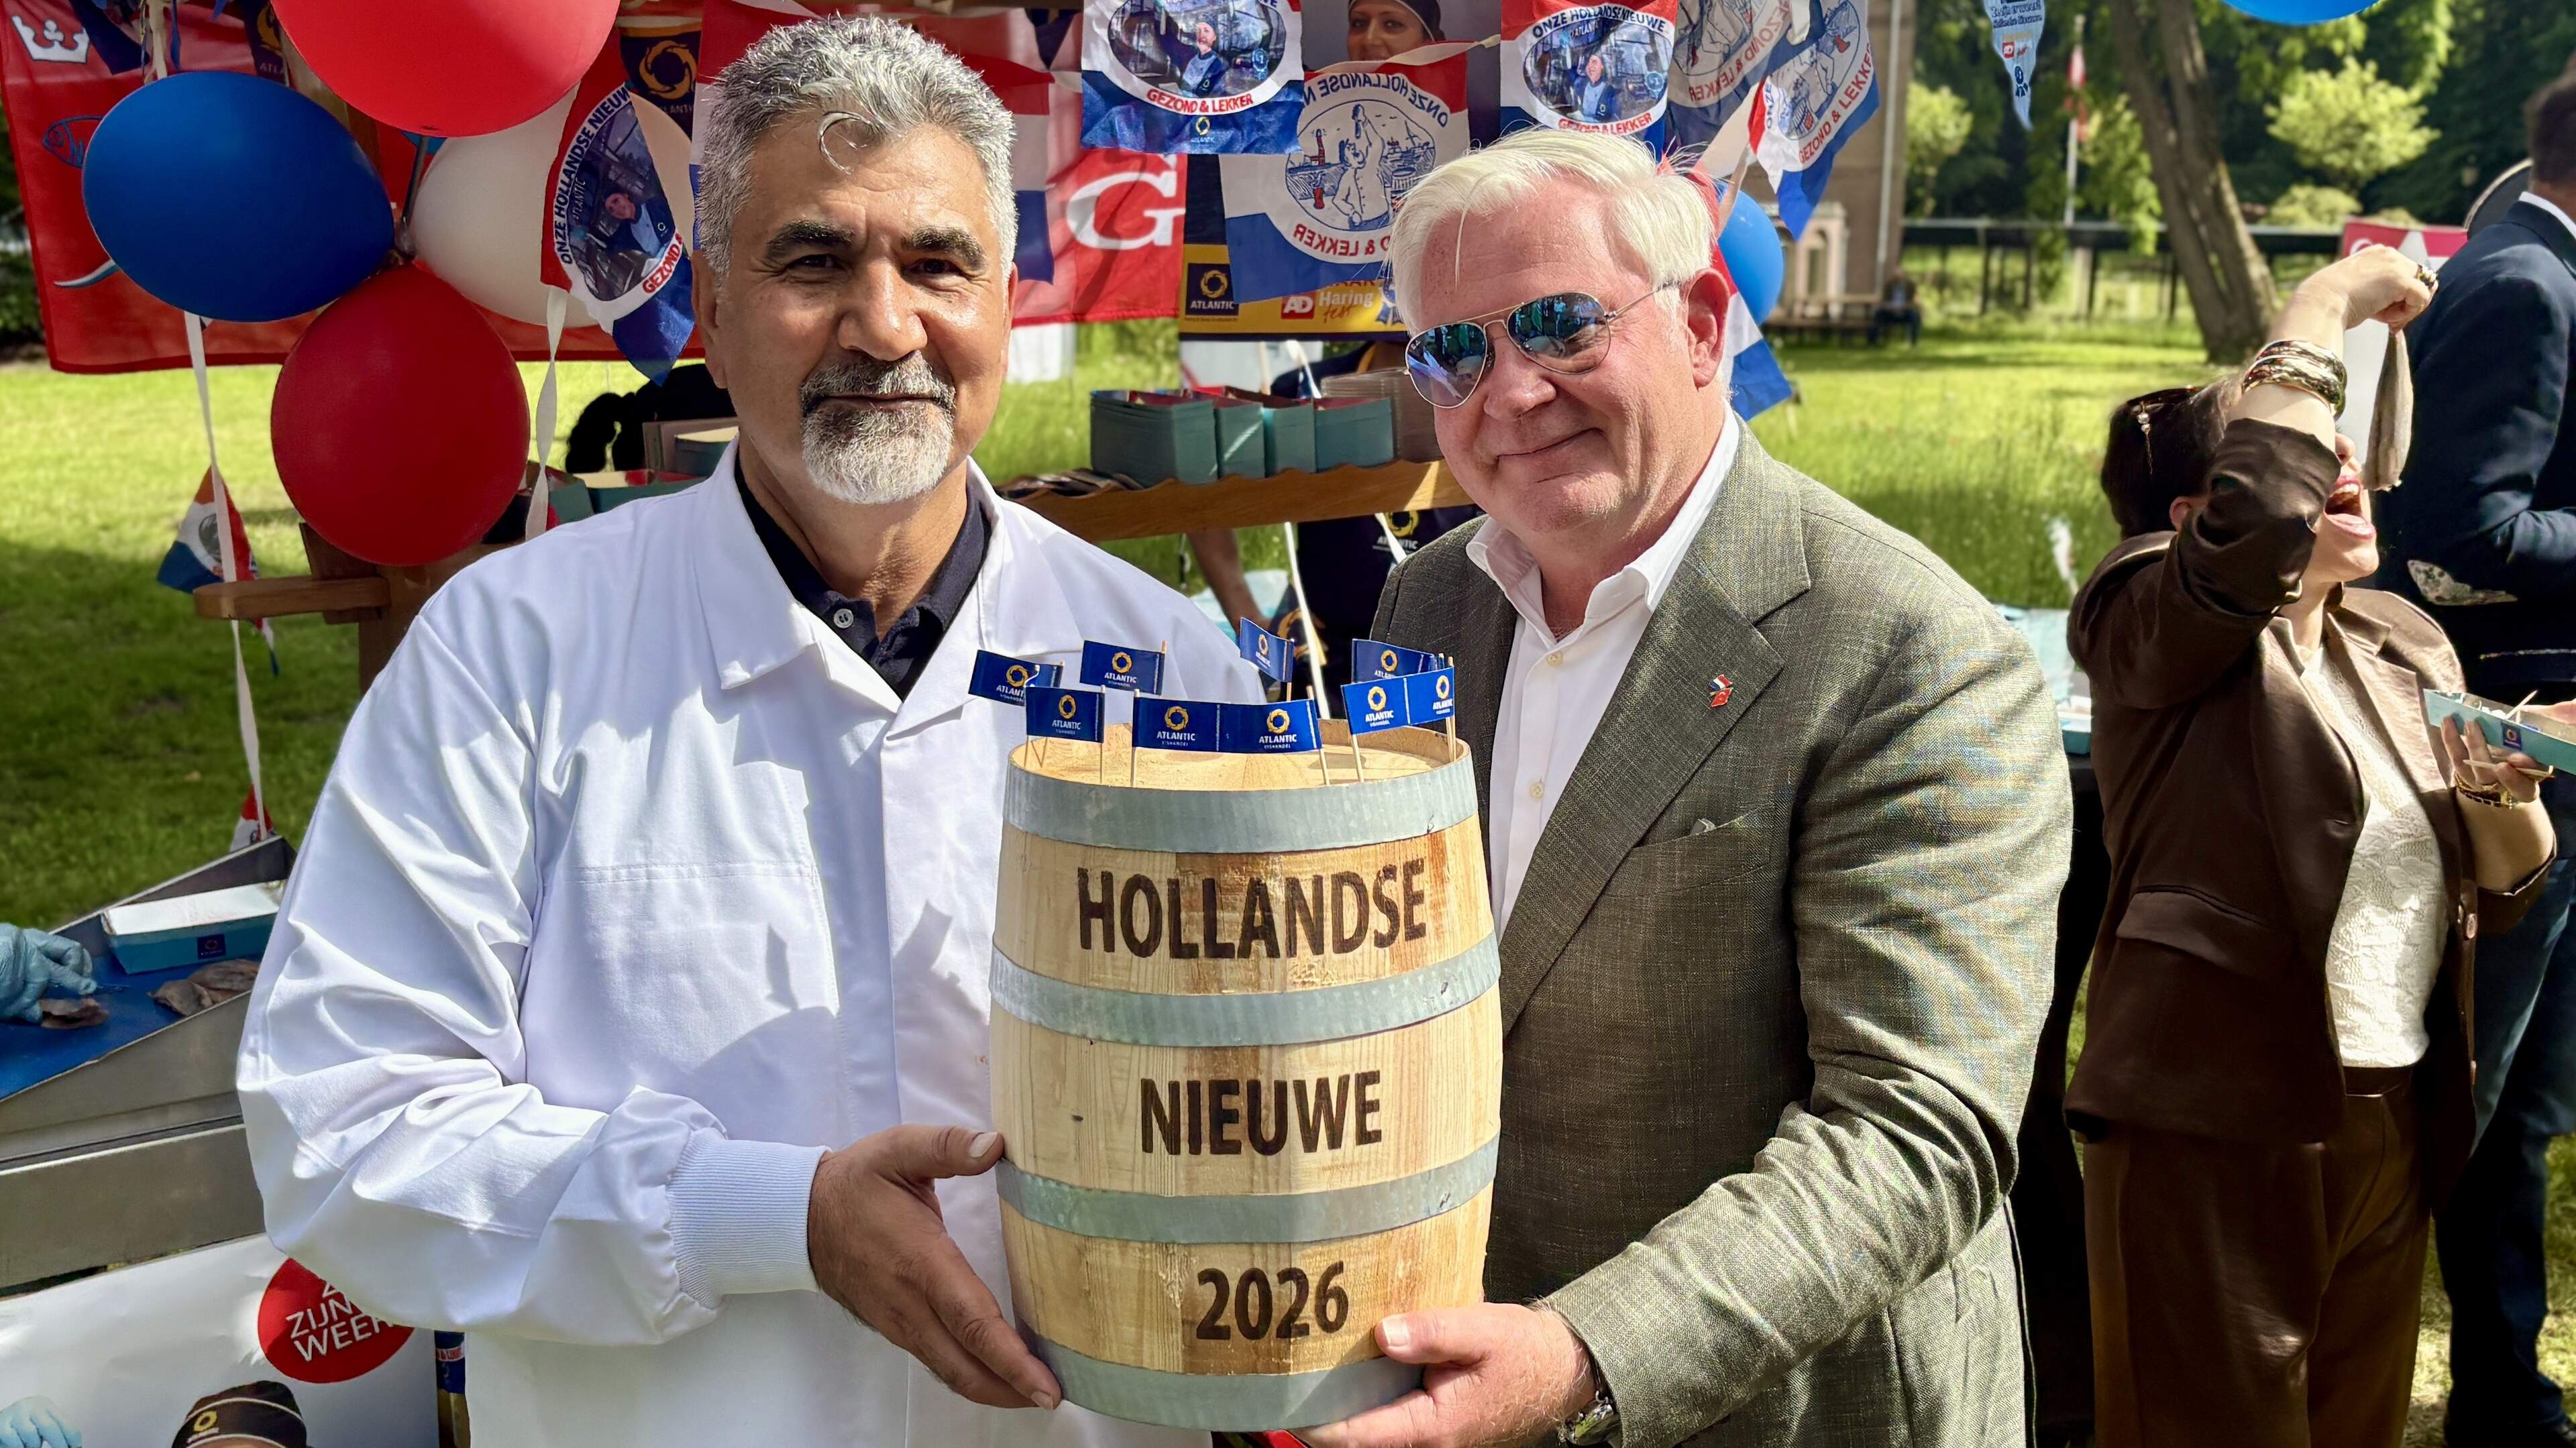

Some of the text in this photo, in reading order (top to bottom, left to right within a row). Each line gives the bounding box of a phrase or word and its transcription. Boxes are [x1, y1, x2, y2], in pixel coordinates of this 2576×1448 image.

[1532, 13, 1567, 38] ONZE
[1147, 88, 1253, 113] GEZOND & LEKKER
[1611, 112, 1652, 135] LEKKER
[1832, 110, 1841, 123] &
[555, 127, 594, 219] HOLLANDSE
[554, 221, 573, 265] ONZE
[642, 243, 681, 294] GEZOND
[1190, 300, 1235, 310] ATLANTIC
[1283, 295, 1313, 314] AD
[1319, 290, 1375, 309] Haring
[1104, 672, 1137, 683] ATLANTIC
[1052, 719, 1081, 730] ATLANTIC
[1365, 710, 1395, 723] ATLANTIC
[1157, 730, 1196, 741] ATLANTIC
[1258, 734, 1297, 744] ATLANTIC
[1077, 857, 1427, 959] HOLLANDSE
[1140, 1070, 1383, 1156] NIEUWE
[1195, 1260, 1349, 1340] 2026
